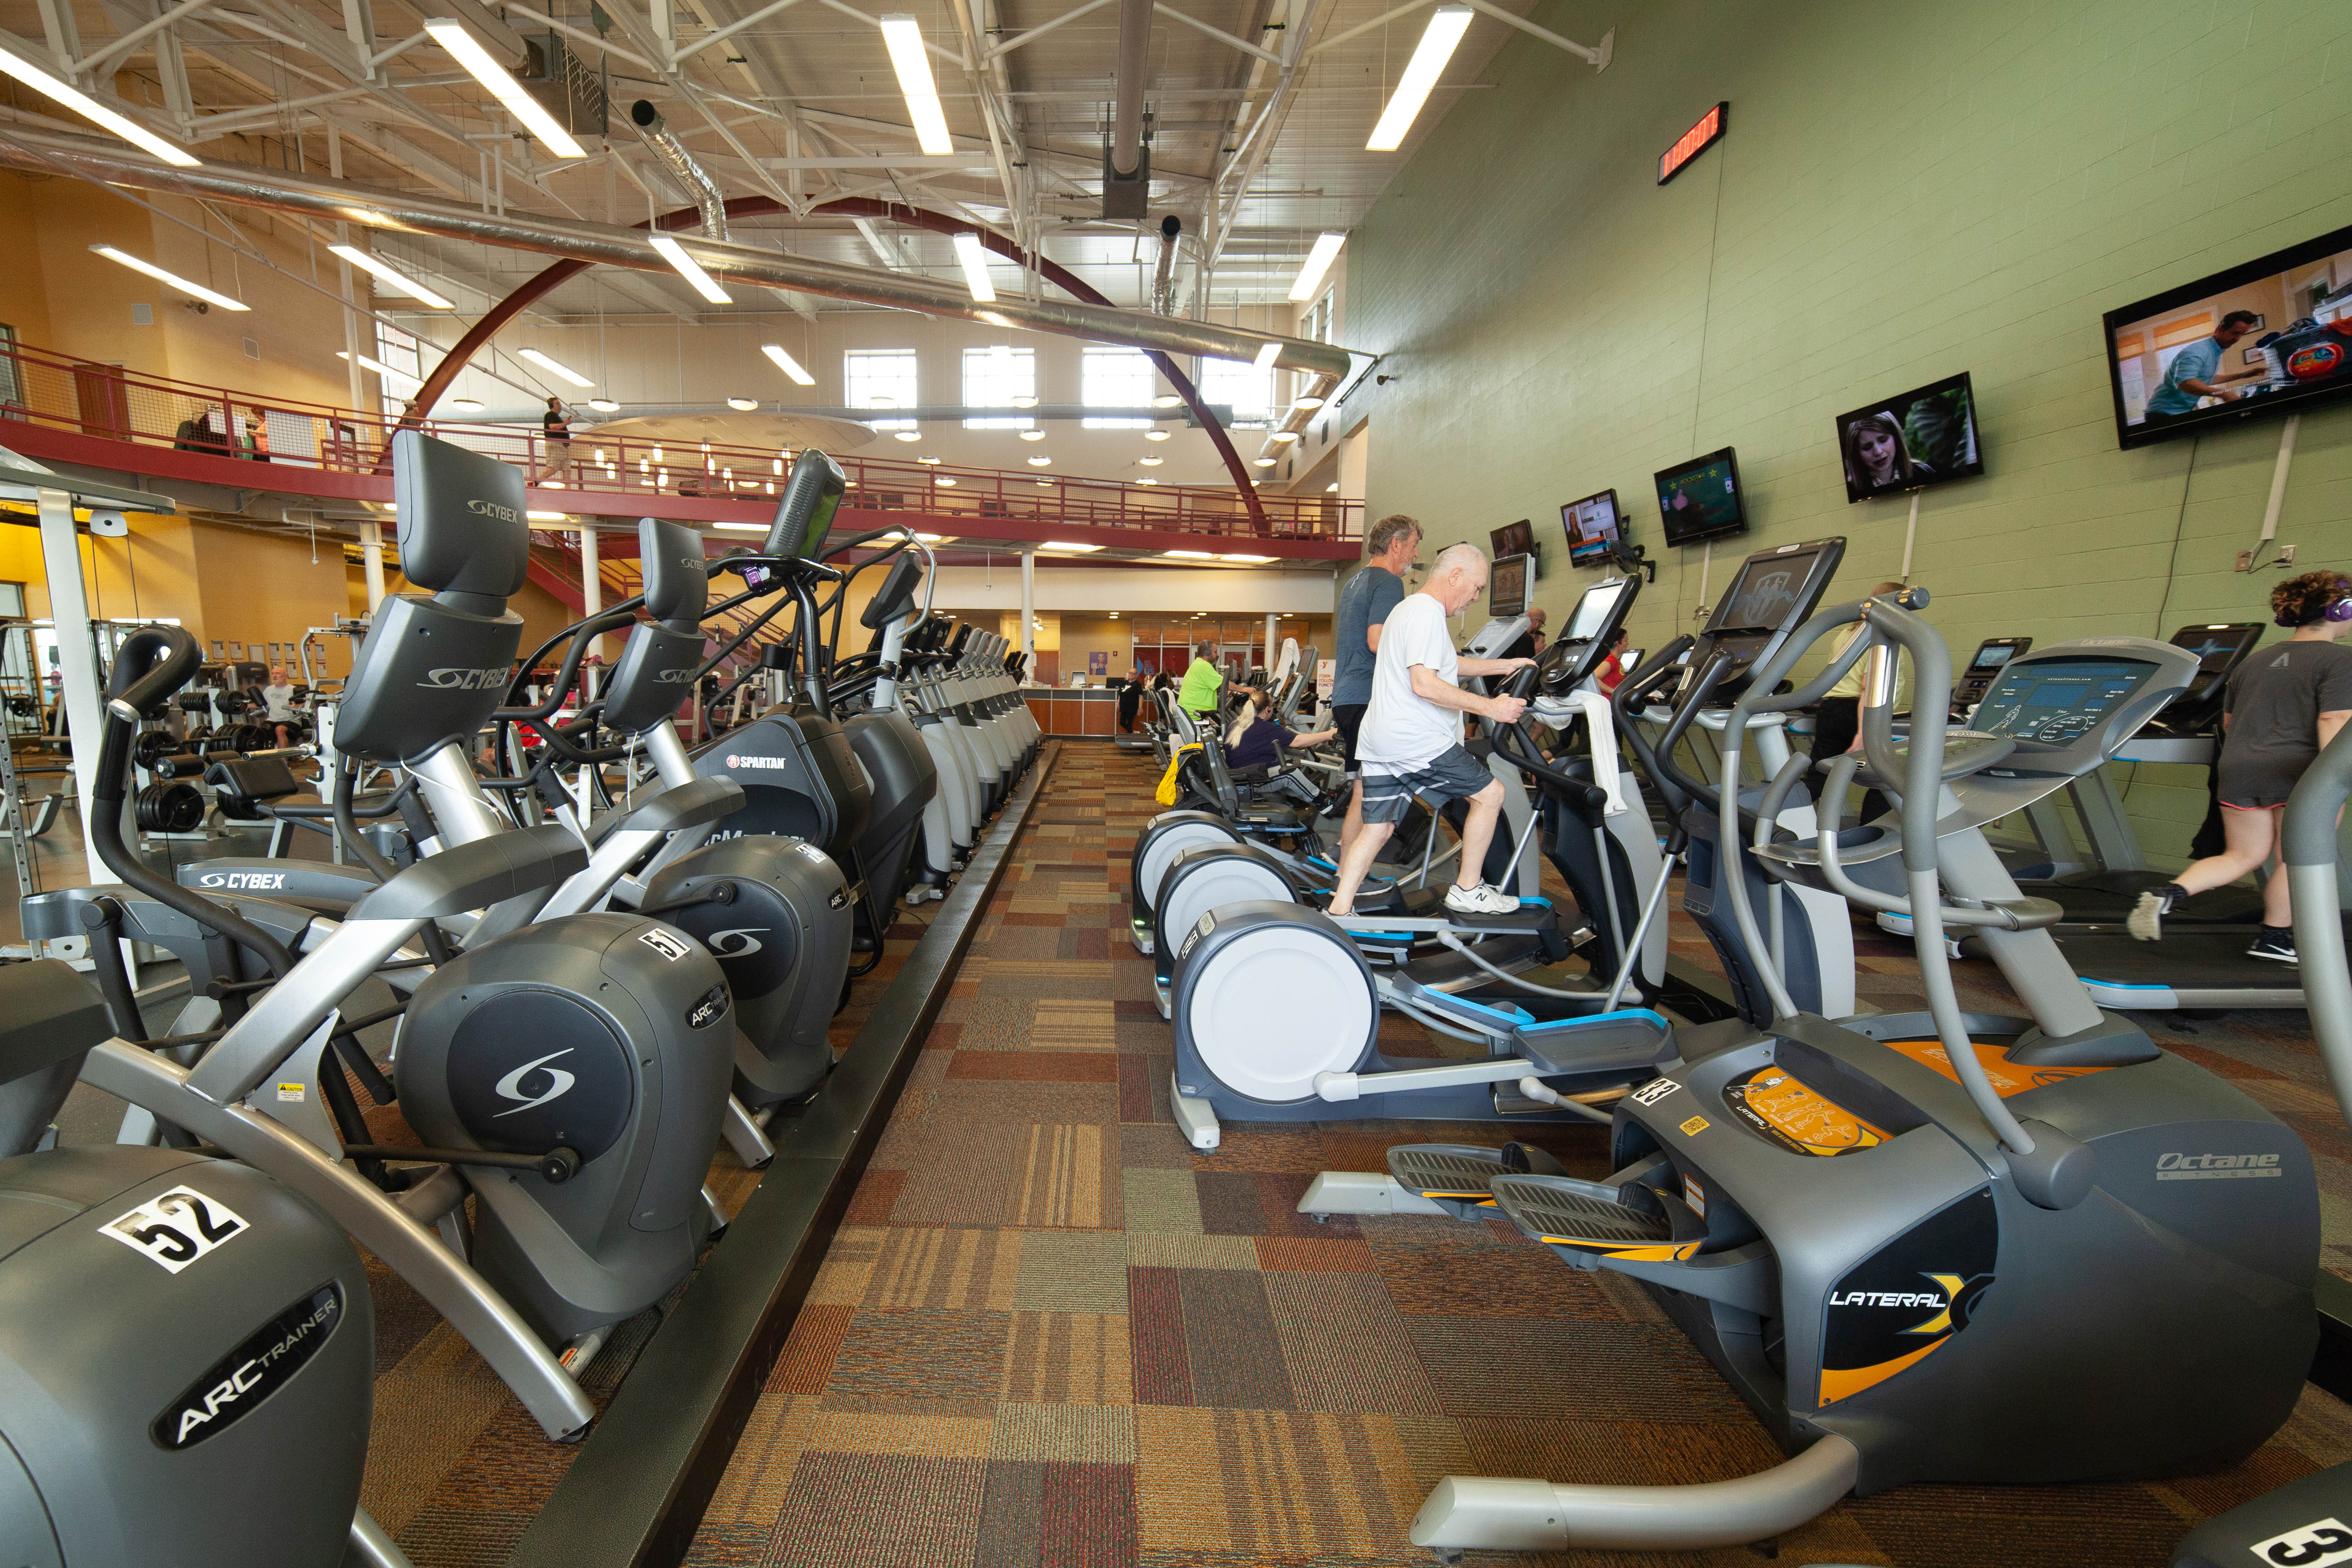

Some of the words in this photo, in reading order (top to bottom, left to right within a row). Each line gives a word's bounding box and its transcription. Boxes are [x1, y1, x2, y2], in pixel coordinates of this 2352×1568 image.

[487, 502, 518, 524] CYBEX
[690, 559, 705, 572] CYBEX
[676, 669, 698, 683] CYBE
[740, 756, 785, 769] SPARTAN
[227, 873, 286, 889] CYBEX
[831, 894, 843, 908] ARC
[642, 930, 687, 958] 51
[692, 1002, 713, 1026] ARC
[1635, 1080, 1677, 1103] 33
[1736, 1106, 1766, 1127] LATERAL
[2157, 1153, 2280, 1170] Octane
[2162, 1170, 2274, 1179] FITNESS
[112, 1193, 240, 1262] 52
[1829, 1291, 1946, 1307] LATERAL
[177, 1359, 263, 1444] ARC
[257, 1298, 337, 1368] TRAINER
